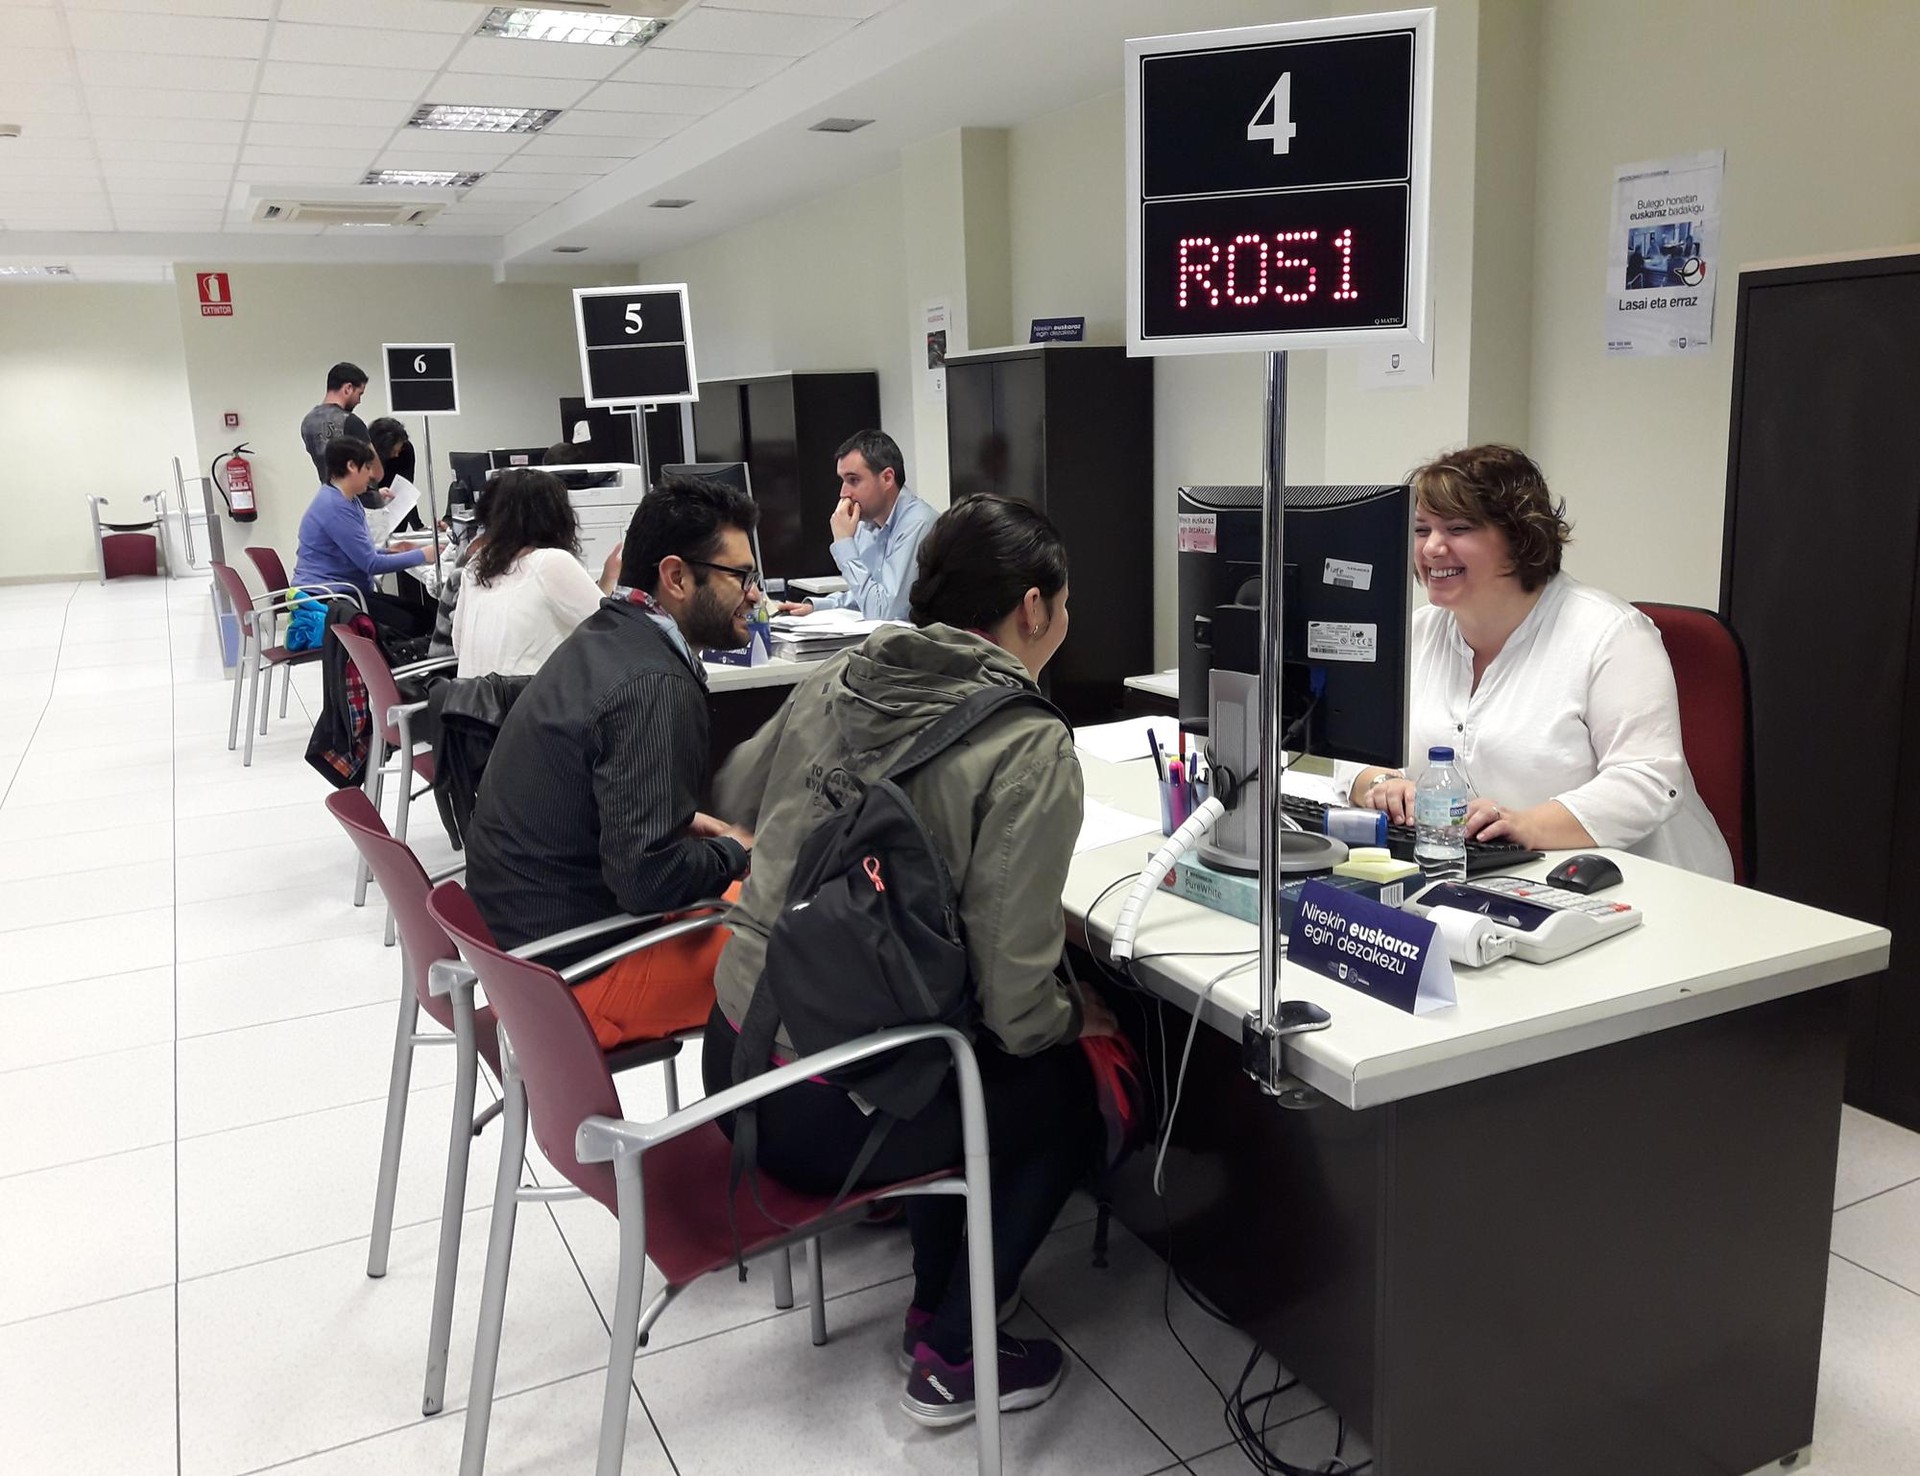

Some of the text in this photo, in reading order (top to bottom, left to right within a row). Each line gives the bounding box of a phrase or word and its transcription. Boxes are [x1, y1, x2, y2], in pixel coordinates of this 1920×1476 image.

[1247, 71, 1297, 155] 4
[1630, 203, 1705, 220] euskaraz badakigu
[1637, 194, 1698, 210] Bulego honetan
[1178, 228, 1359, 308] R051
[202, 305, 231, 315] EXTINTOR
[1618, 294, 1698, 312] Lasai eta erraz
[623, 302, 643, 335] 5
[413, 353, 427, 374] 6
[1302, 901, 1420, 960] Nirekin euskaraz
[1304, 924, 1406, 975] egin dezakezu
